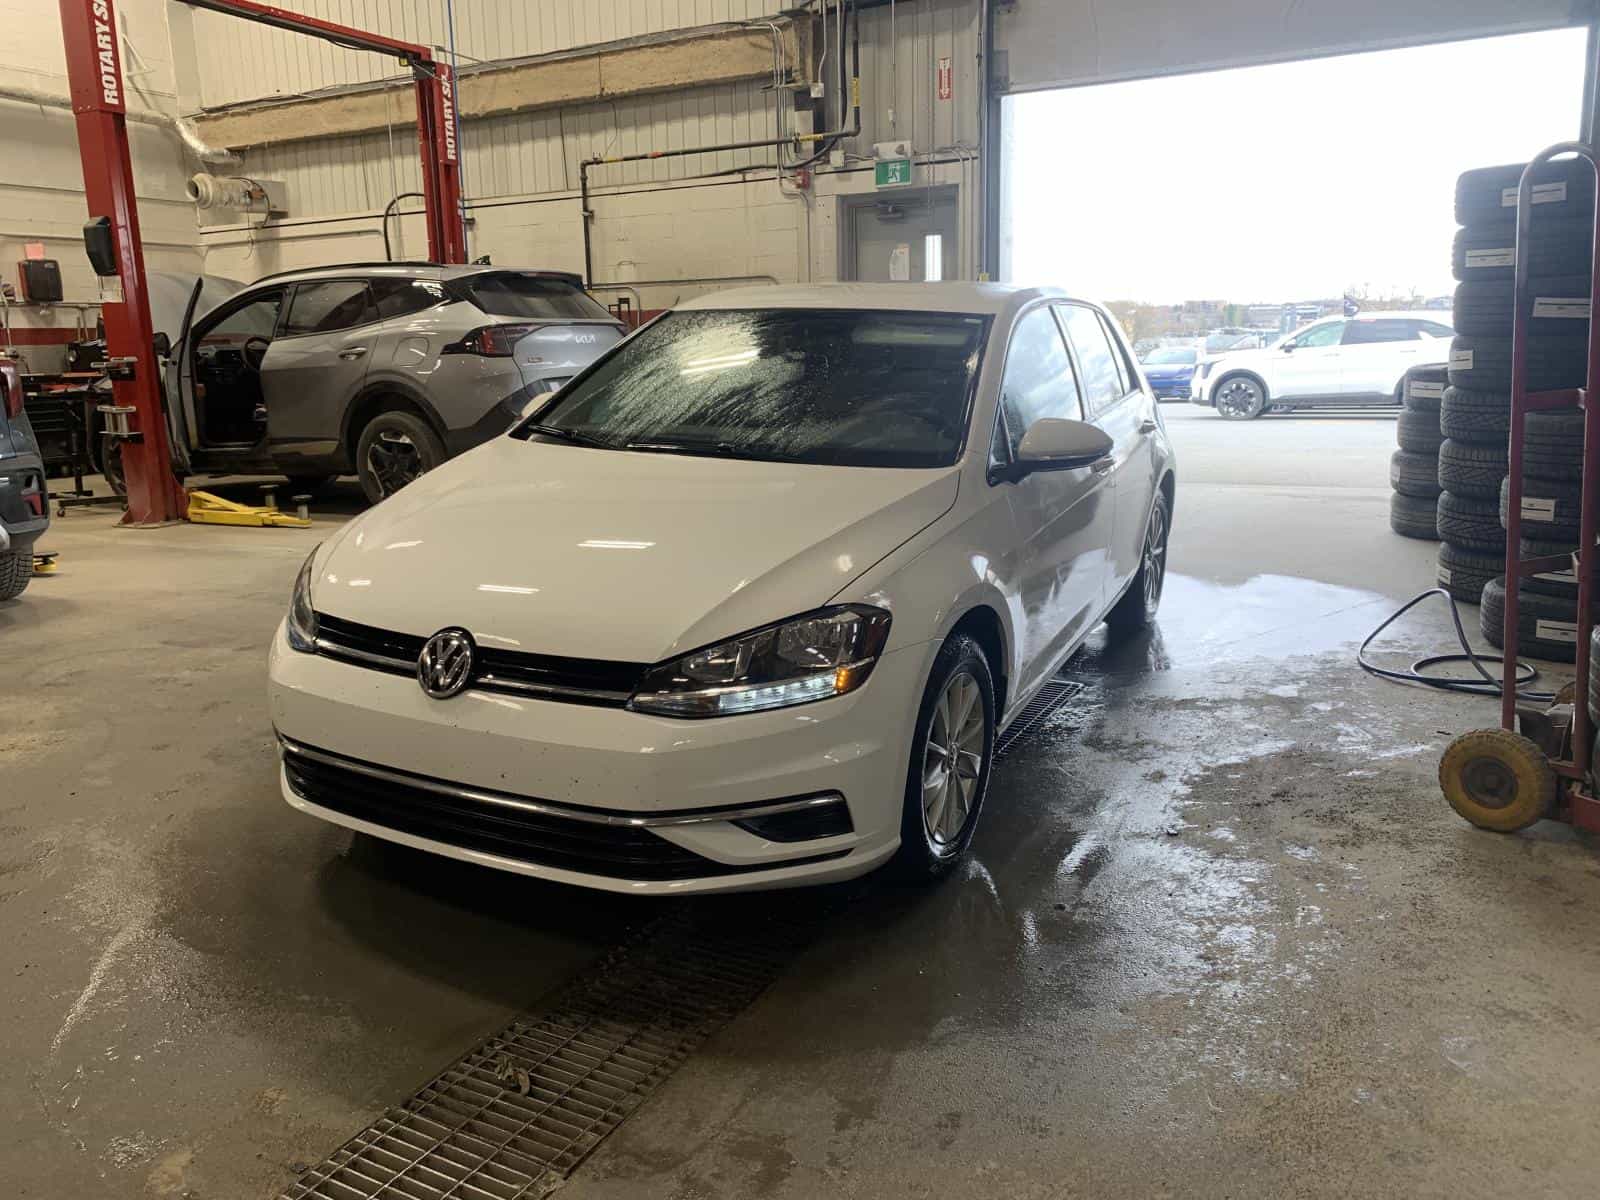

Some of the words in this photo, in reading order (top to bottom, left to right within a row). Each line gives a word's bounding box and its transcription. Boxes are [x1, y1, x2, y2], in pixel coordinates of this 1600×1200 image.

[95, 19, 119, 105] ROTARY
[443, 98, 457, 160] ROTARY
[575, 334, 597, 344] KIA
